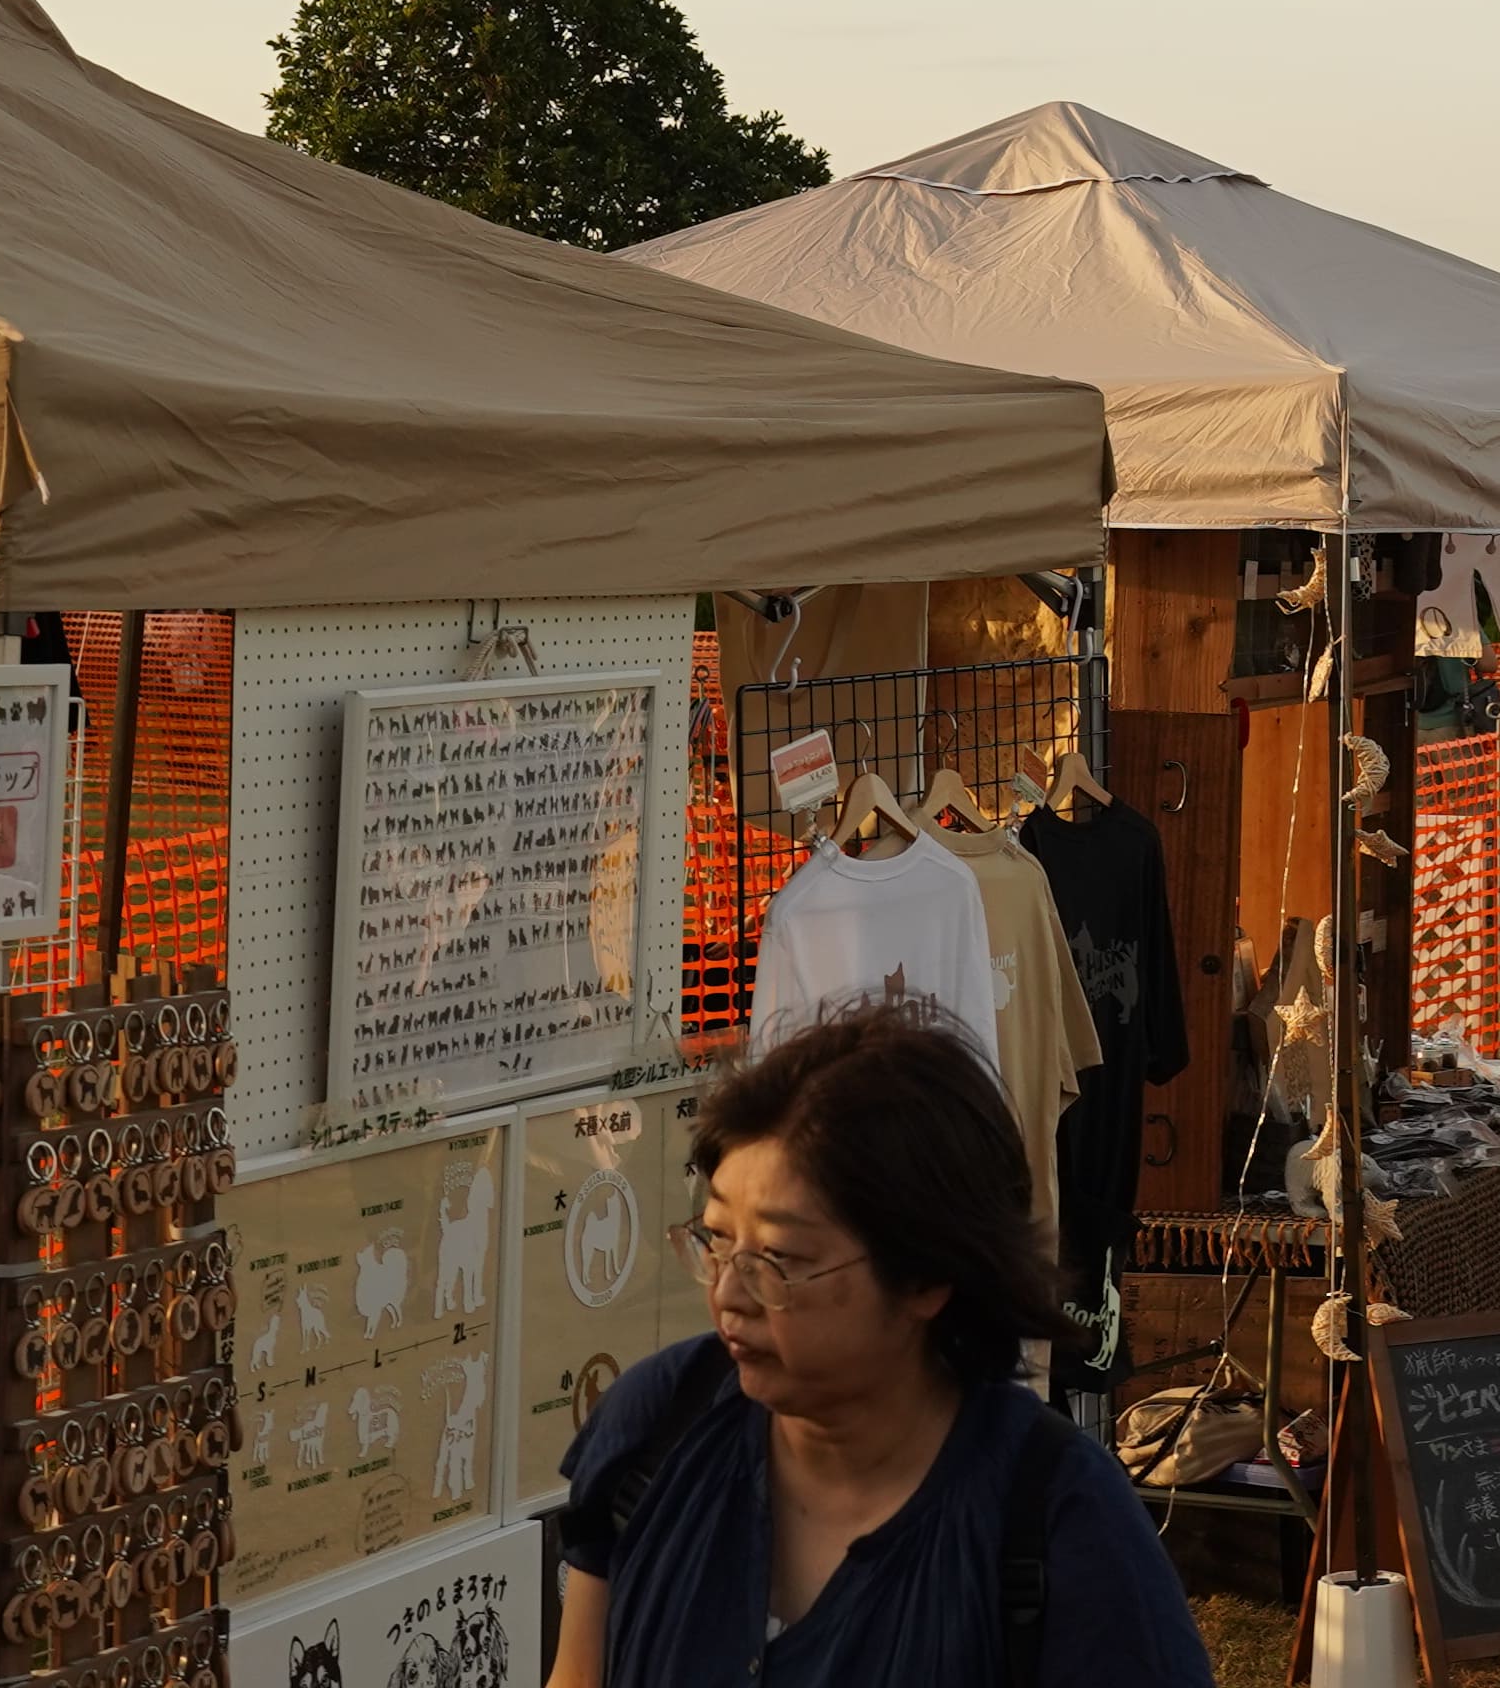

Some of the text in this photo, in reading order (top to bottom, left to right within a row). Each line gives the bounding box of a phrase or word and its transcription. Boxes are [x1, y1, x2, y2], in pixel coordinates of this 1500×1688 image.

[554, 1189, 567, 1211] 大
[257, 1381, 266, 1402] S
[305, 1366, 316, 1388] M
[373, 1347, 382, 1368] L
[561, 1370, 573, 1391] 小
[386, 1572, 508, 1645] つきの & まろすけ
